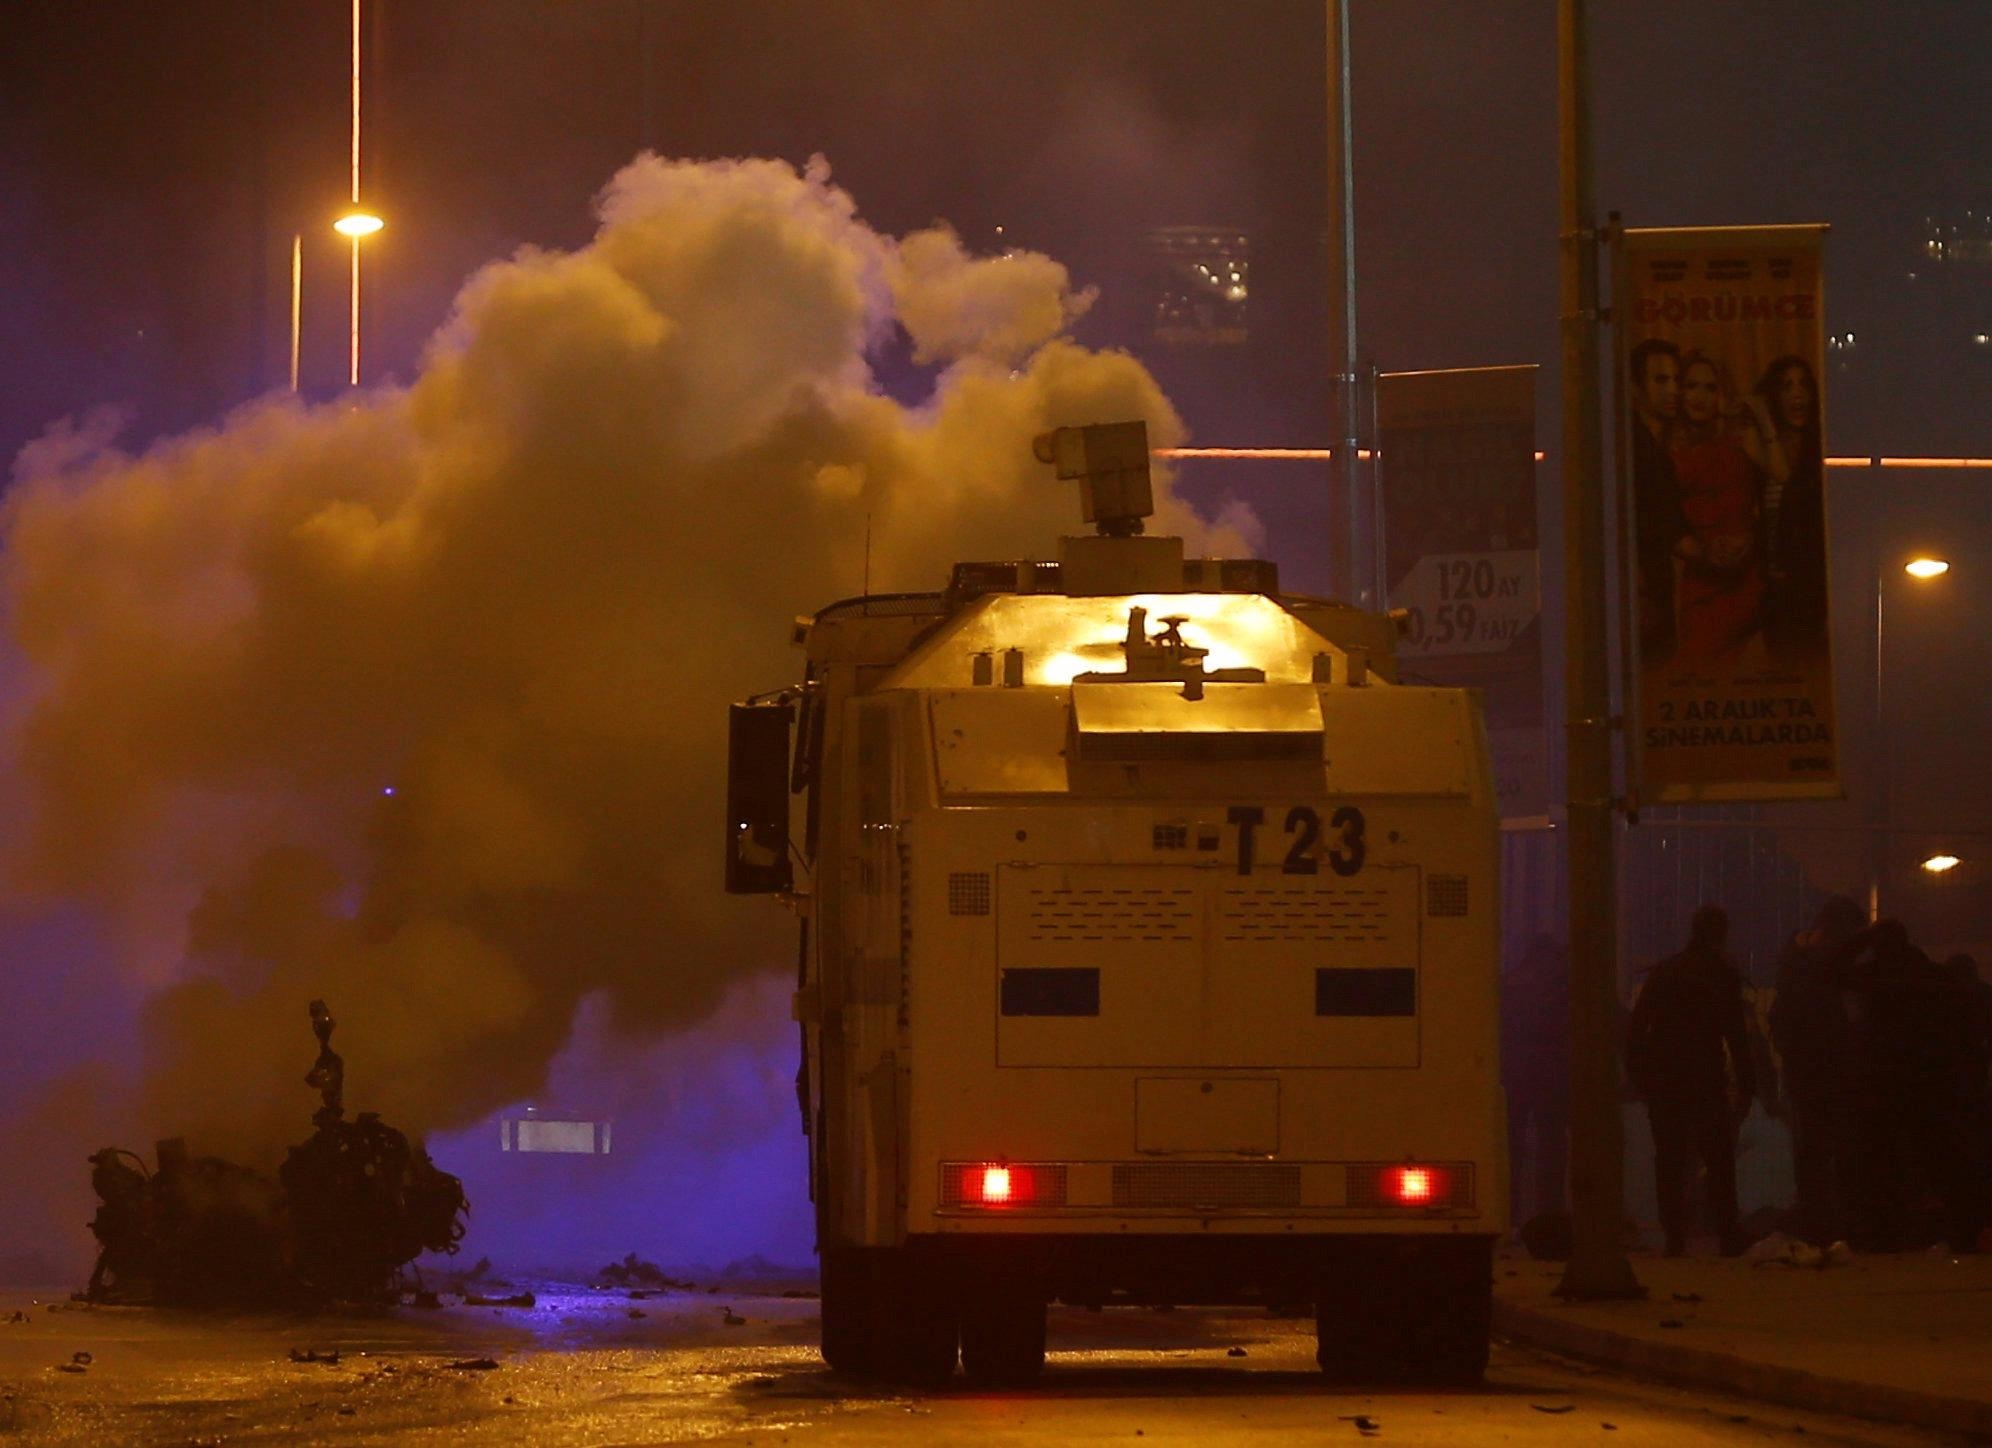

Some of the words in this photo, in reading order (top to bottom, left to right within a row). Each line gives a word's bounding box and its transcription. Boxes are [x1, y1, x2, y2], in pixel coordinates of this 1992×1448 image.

[1437, 559, 1495, 600] 120
[1498, 576, 1520, 597] AY
[1408, 603, 1477, 651] 0,59
[1658, 701, 1675, 721] 2
[1227, 806, 1264, 875] T
[1282, 806, 1366, 877] 23
